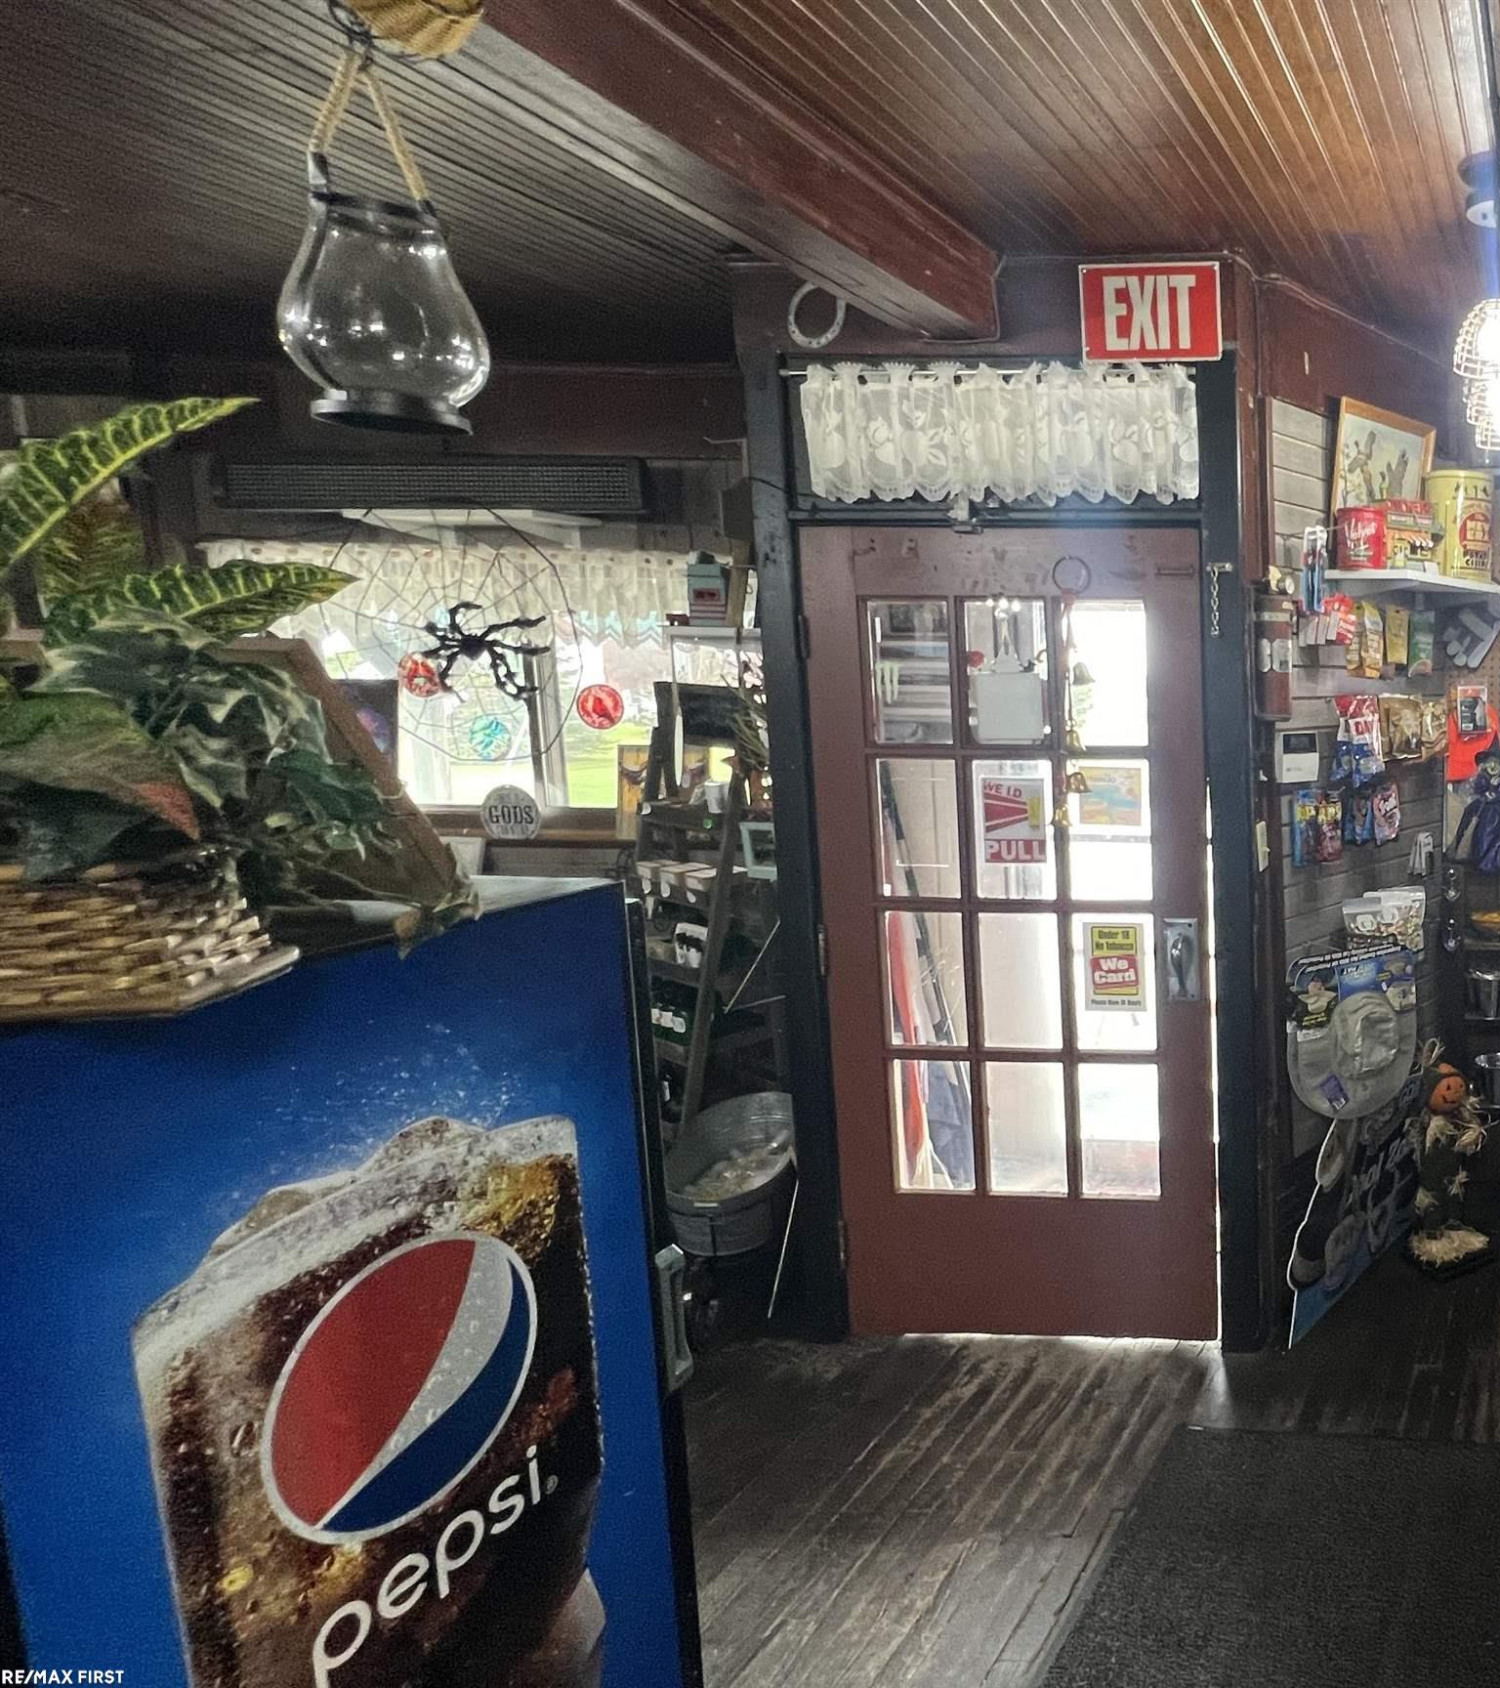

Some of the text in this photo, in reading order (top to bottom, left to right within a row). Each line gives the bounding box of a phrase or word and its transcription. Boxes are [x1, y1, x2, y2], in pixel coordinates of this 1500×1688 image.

[1102, 274, 1196, 351] EXIT
[984, 781, 1003, 794] WE
[489, 805, 534, 824] GODS
[985, 841, 1045, 861] PULL
[1099, 957, 1129, 971] We
[1094, 968, 1137, 984] Card
[313, 1445, 541, 1688] pepsi
